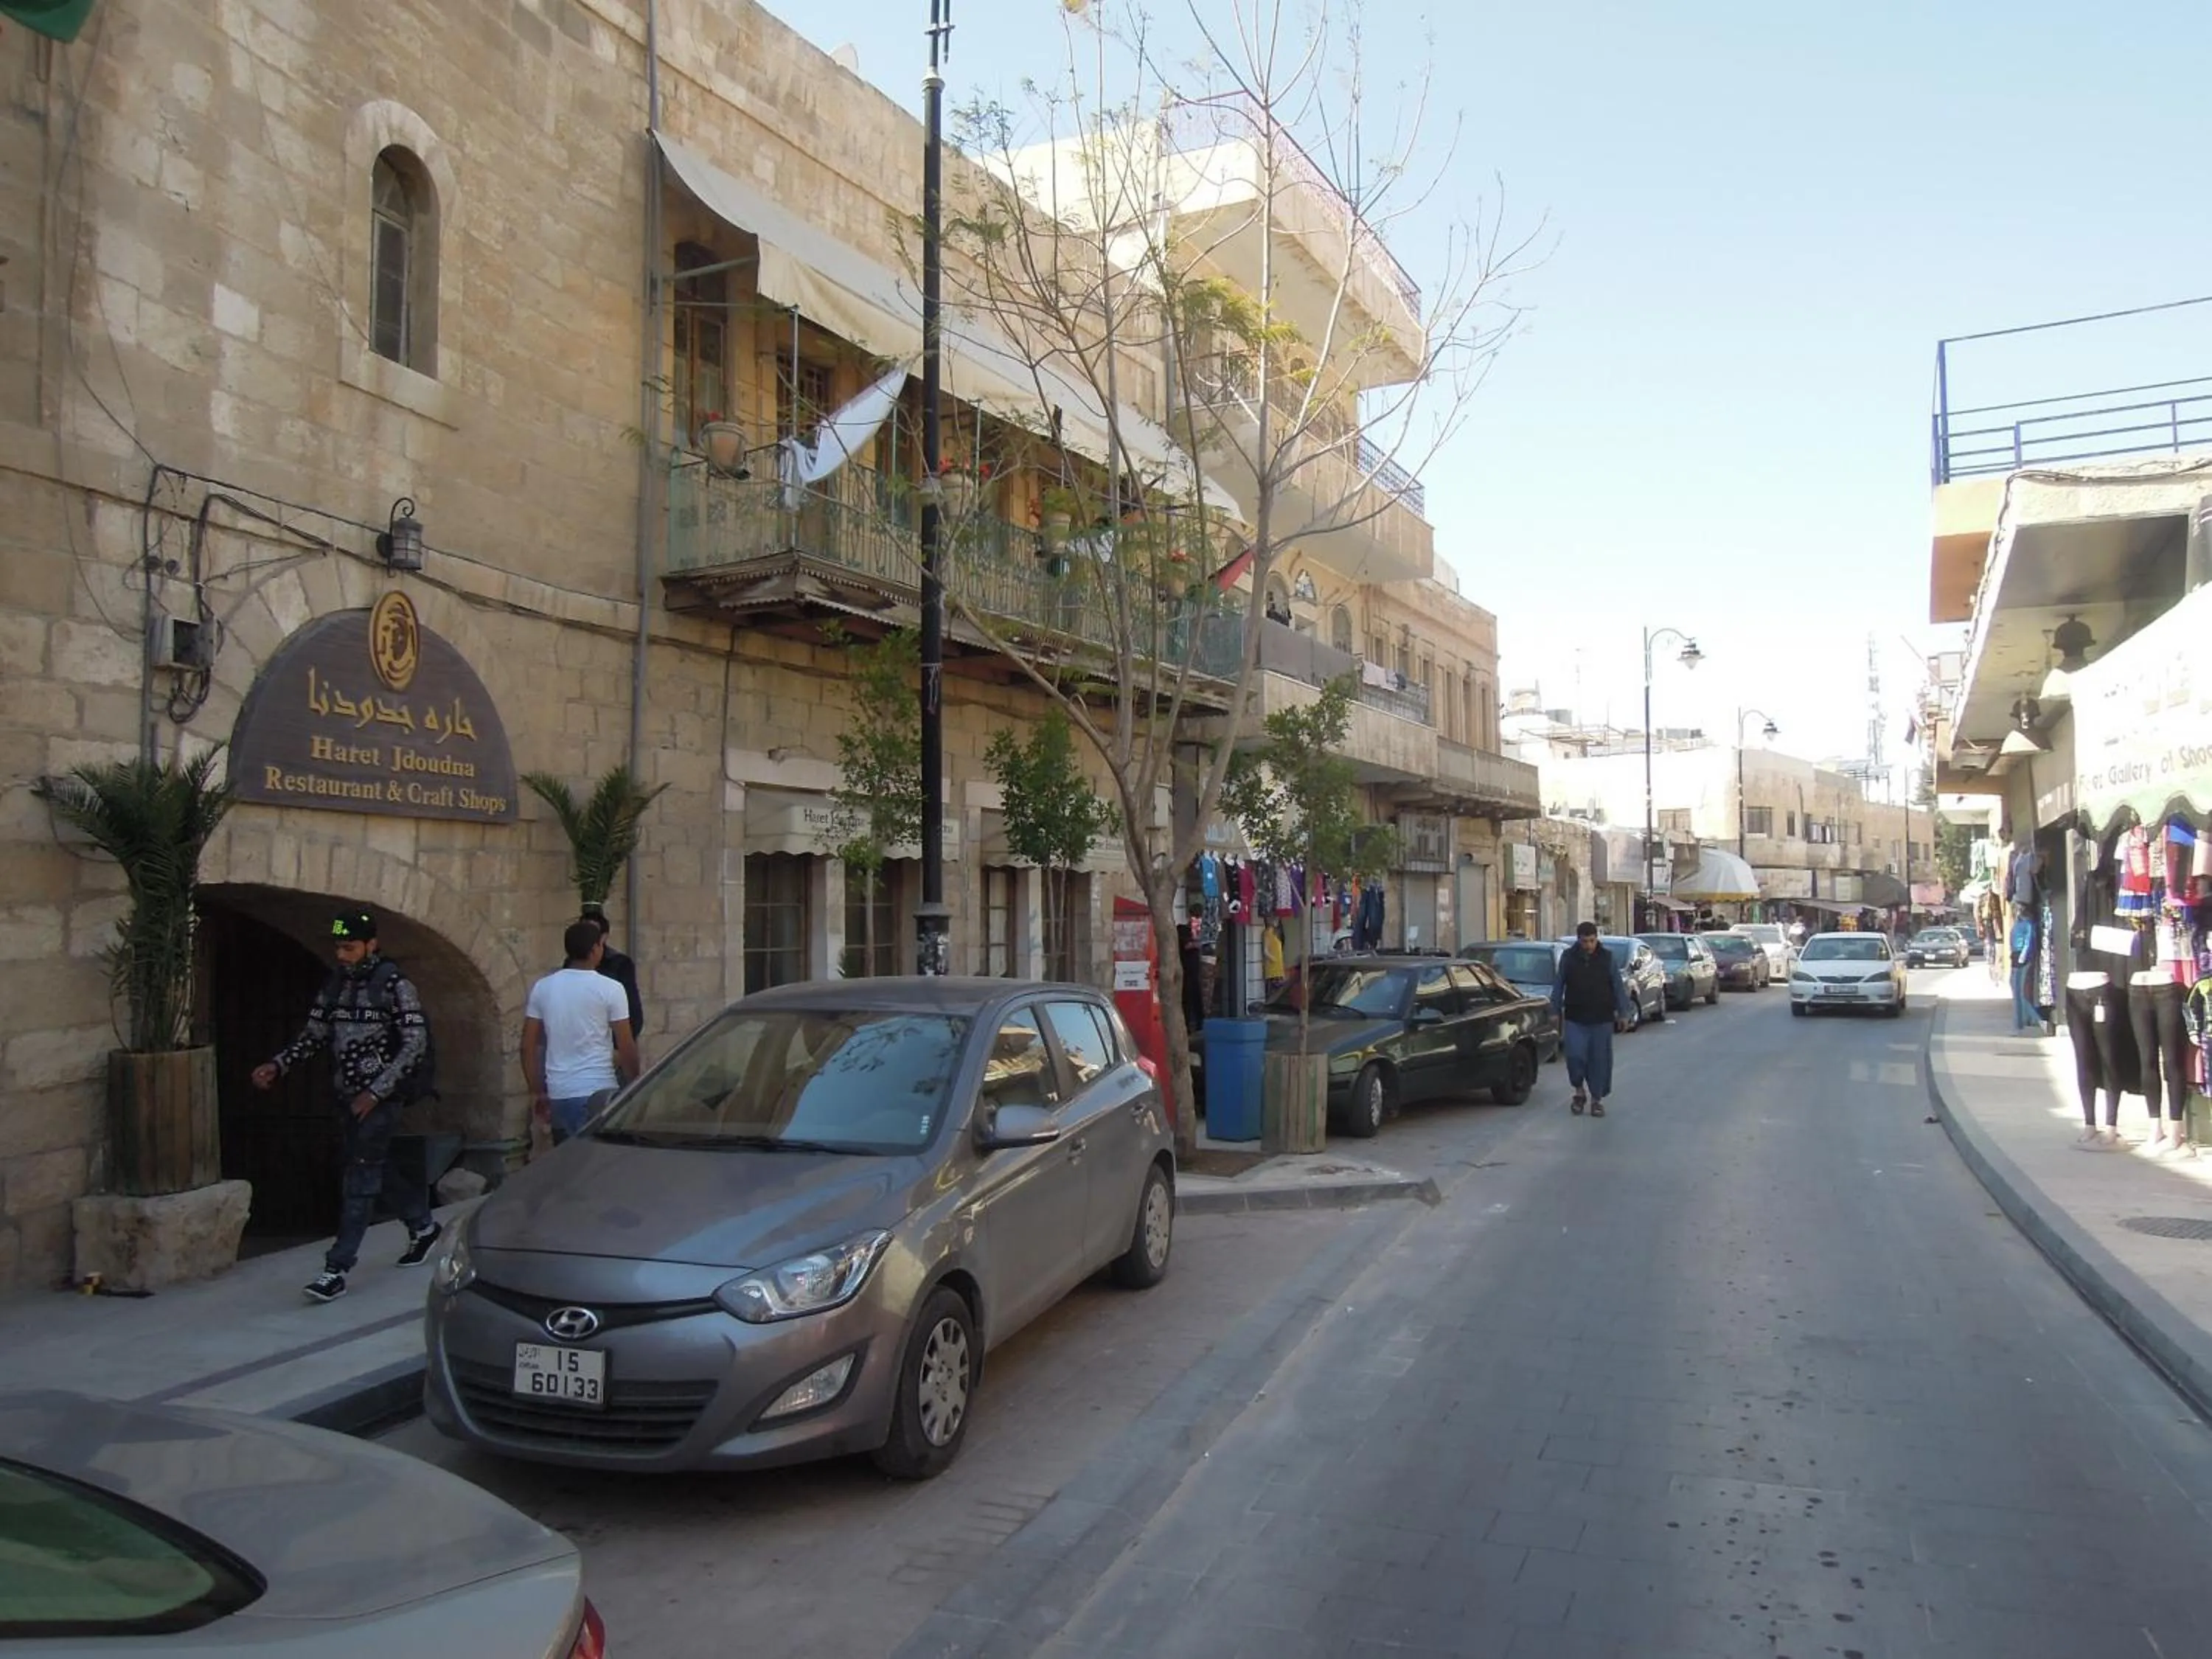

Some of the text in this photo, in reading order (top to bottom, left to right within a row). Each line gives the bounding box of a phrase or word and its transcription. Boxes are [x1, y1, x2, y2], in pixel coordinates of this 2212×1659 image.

[307, 667, 415, 734] جدودنا
[310, 736, 475, 777] Haret Jdoudna
[2108, 761, 2152, 784] Gallery
[2160, 750, 2175, 774] of
[265, 766, 507, 815] Restaurant & Craft Shops
[558, 1350, 579, 1372] 15
[532, 1372, 598, 1399] 60133
